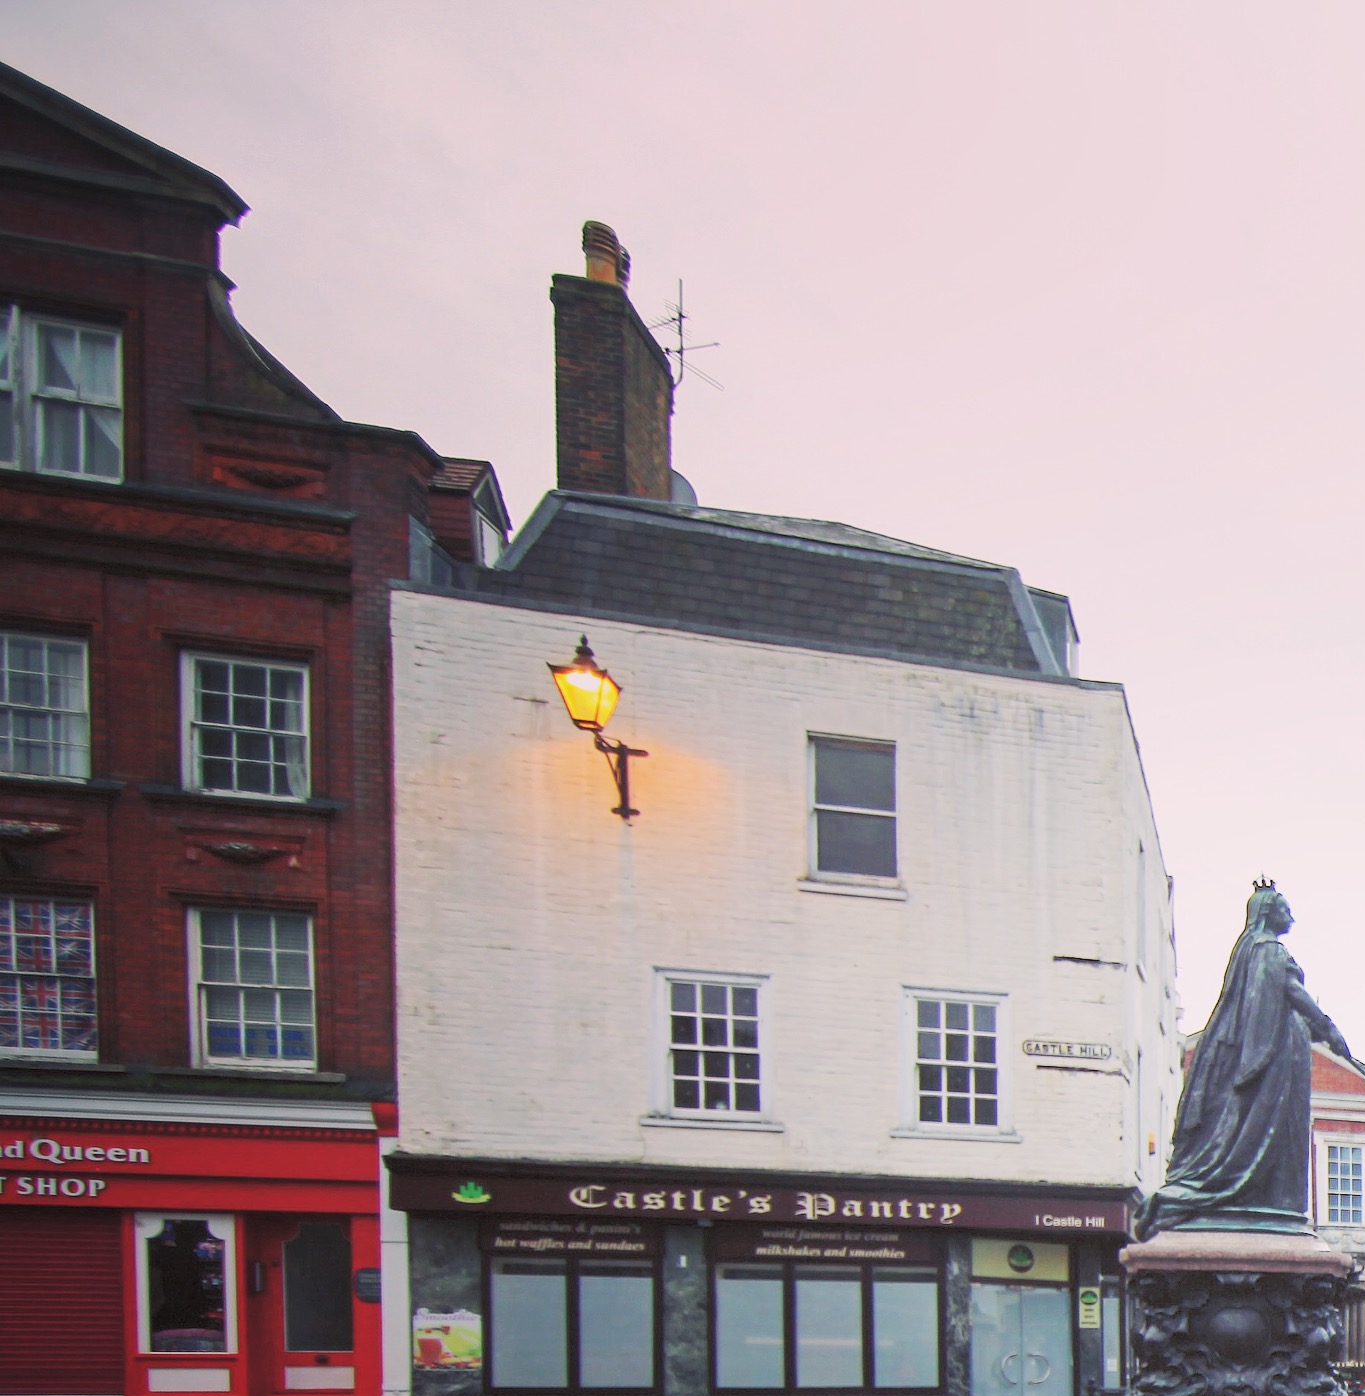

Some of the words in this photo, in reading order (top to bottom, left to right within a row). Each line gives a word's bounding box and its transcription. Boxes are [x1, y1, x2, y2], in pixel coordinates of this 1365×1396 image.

[1026, 1043, 1073, 1055] CASTLE
[1080, 1046, 1107, 1057] HILL
[0, 1140, 24, 1158] d
[30, 1139, 149, 1164] Queen
[16, 1177, 106, 1197] SHOP
[569, 1185, 772, 1214] Castle's
[795, 1192, 962, 1224] Pantry
[1043, 1214, 1082, 1228] Castle
[1085, 1216, 1105, 1228] Hill
[519, 1238, 564, 1251] waffles
[568, 1239, 593, 1250] and
[595, 1240, 645, 1251] sundaes
[756, 1244, 821, 1256] milkshakes
[824, 1246, 847, 1257] and
[849, 1247, 905, 1259] smoothies
